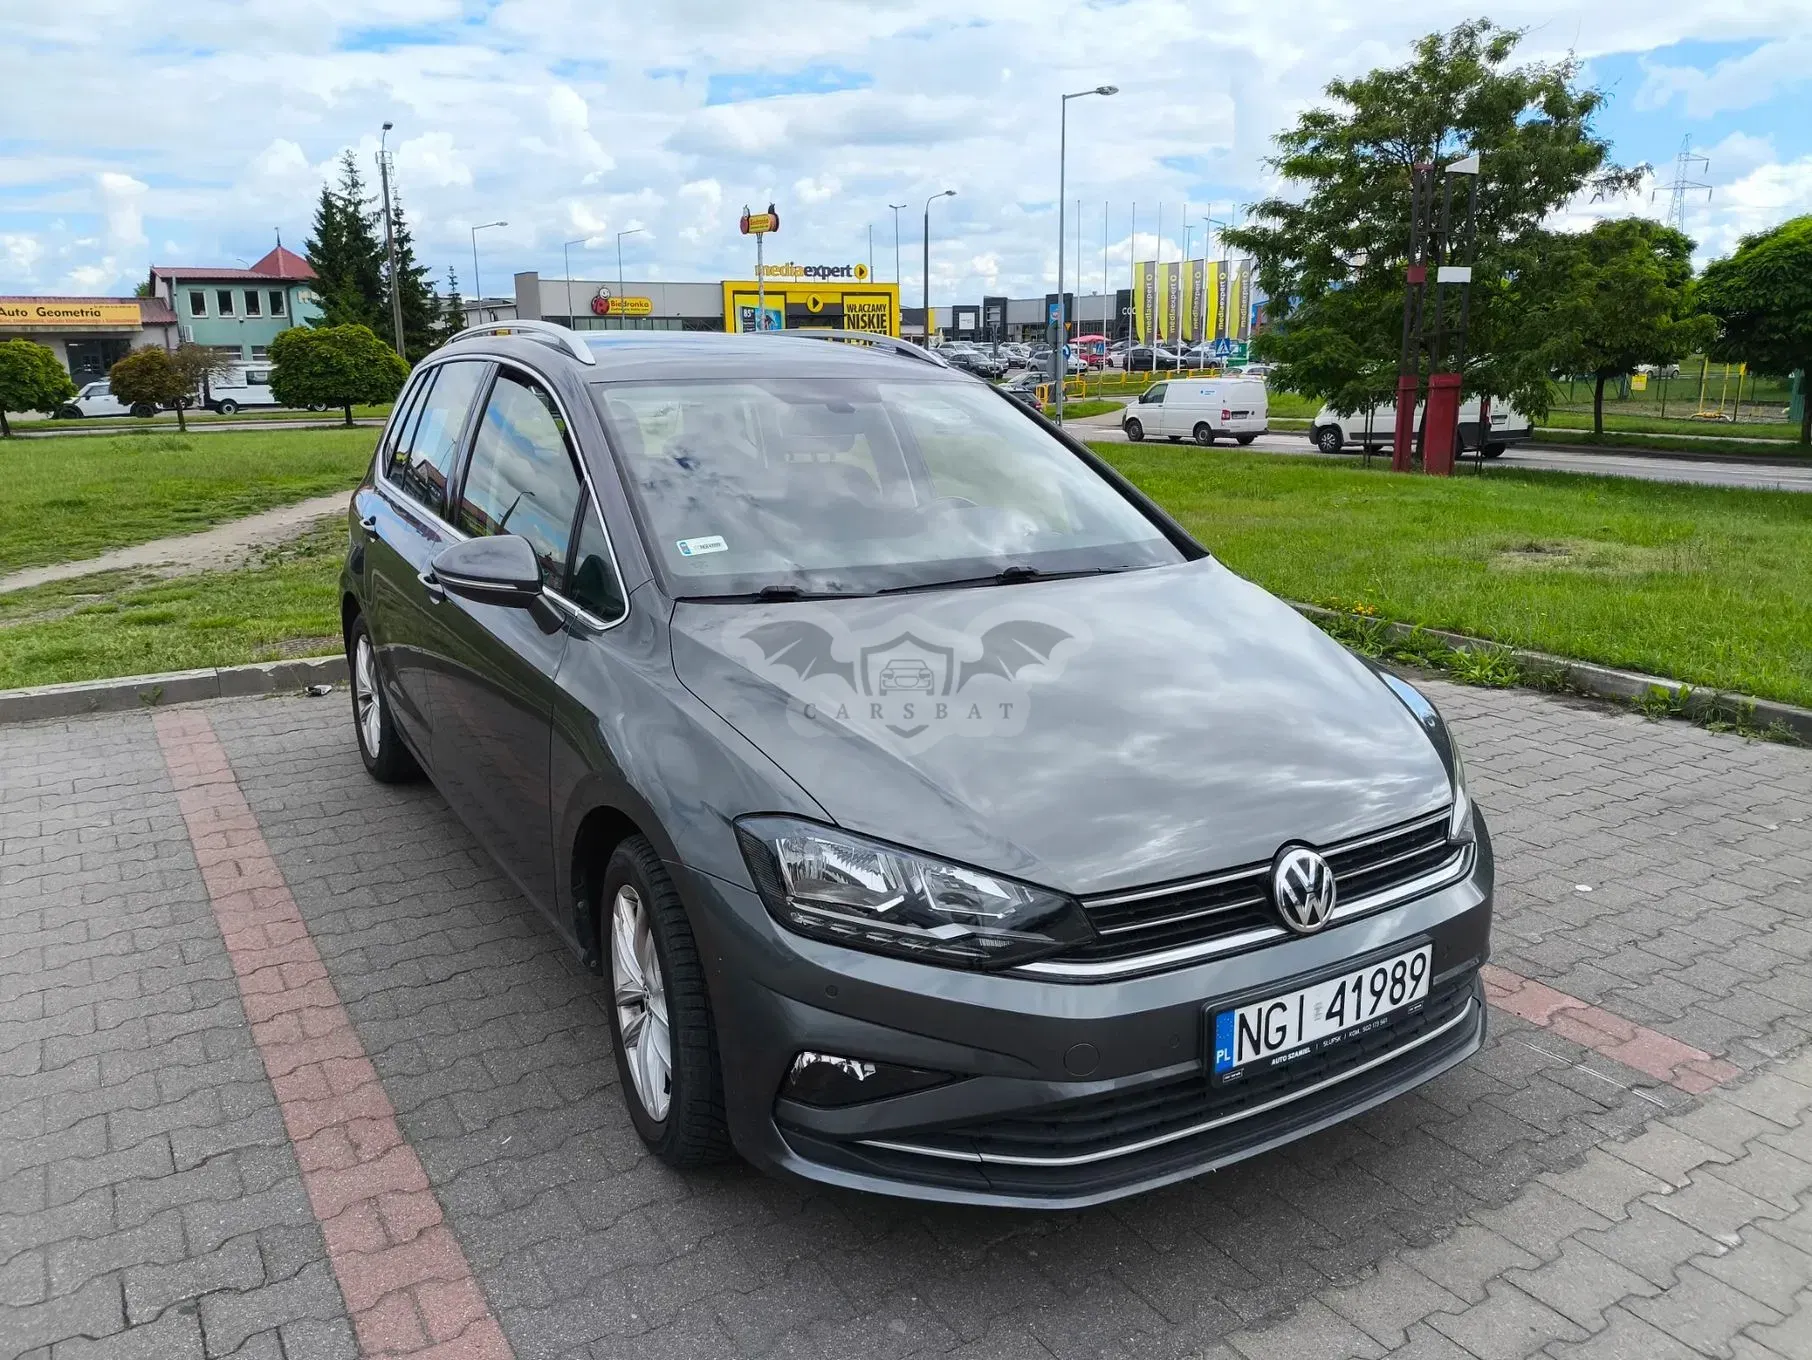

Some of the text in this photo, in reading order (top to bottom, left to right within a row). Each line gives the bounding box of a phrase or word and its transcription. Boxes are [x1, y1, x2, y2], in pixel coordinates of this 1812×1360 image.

[36, 307, 101, 317] Geometria
[846, 313, 887, 330] NISKIE
[1237, 952, 1427, 1062] NGI 41989
[1216, 1048, 1231, 1064] PL
[1271, 1054, 1288, 1066] AUTO
